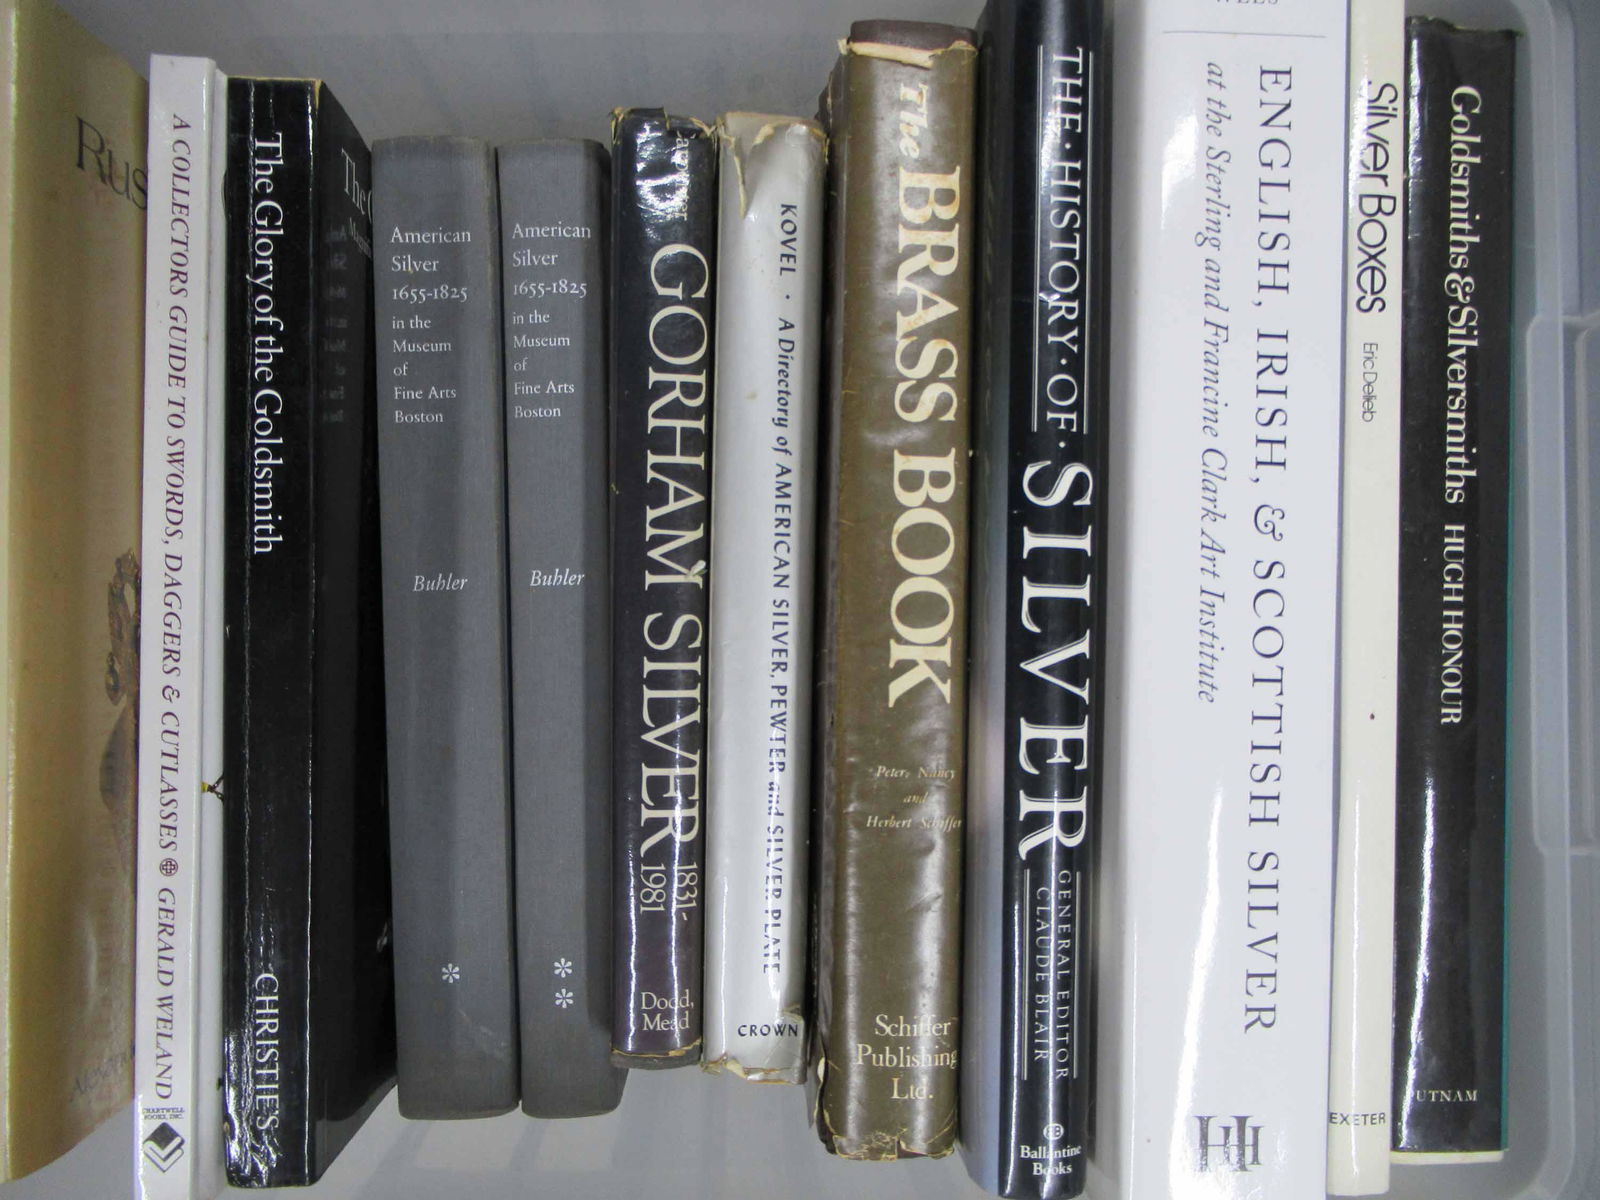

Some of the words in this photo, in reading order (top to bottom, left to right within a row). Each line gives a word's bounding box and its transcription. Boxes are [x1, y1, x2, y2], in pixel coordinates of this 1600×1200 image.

[1051, 47, 1084, 133] THE
[1205, 62, 1226, 89] at
[172, 114, 191, 131] A
[898, 83, 930, 160] The
[1204, 97, 1230, 137] the
[1358, 81, 1398, 187] Silver
[252, 132, 283, 193] The
[1251, 65, 1292, 307] ENGLISH,
[1447, 85, 1483, 268] Goldsmiths
[168, 139, 191, 297] COLLECTORS
[1194, 146, 1231, 251] Sterling
[245, 200, 283, 290] Glory
[390, 226, 472, 244] American
[512, 221, 592, 239] American
[777, 203, 797, 276] KOVEL
[1045, 160, 1081, 353] HISTORY
[1355, 194, 1397, 313] Boxes
[391, 254, 440, 272] Silver
[512, 249, 559, 268] Silver
[1202, 258, 1229, 312] and
[252, 295, 283, 331] of
[392, 284, 468, 304] 1655-1825
[513, 278, 588, 298] 1655-1825
[893, 165, 961, 422] BRASS
[1443, 272, 1475, 303] &
[392, 316, 405, 330] in
[409, 315, 432, 330] the
[513, 312, 524, 325] in
[529, 309, 551, 324] the
[513, 335, 571, 349] Museum
[777, 318, 795, 333] A
[166, 305, 188, 387] GUIDE
[252, 335, 283, 382] the
[392, 339, 452, 353] Museum
[393, 361, 409, 377] of
[514, 357, 529, 372] of
[1361, 343, 1379, 371] Eric
[394, 386, 423, 400] Fine
[428, 385, 457, 400] Arts
[514, 381, 541, 396] Fine
[545, 380, 575, 395] Arts
[770, 339, 796, 428] Directory
[1044, 373, 1078, 432] OF
[1200, 317, 1229, 437] Francine
[1360, 371, 1379, 423] Delieb
[1443, 305, 1480, 504] Silversmiths
[165, 395, 186, 429] TO
[395, 410, 444, 424] Boston
[514, 405, 562, 418] Boston
[642, 243, 709, 590] GORHAM
[1248, 328, 1289, 484] IRISH,
[252, 389, 283, 554] Goldsmith
[772, 436, 792, 457] of
[161, 436, 185, 545] SWORDS,
[1199, 448, 1228, 521] Clark
[771, 463, 792, 589] AMERICAN
[1252, 503, 1286, 541] &
[413, 572, 468, 592] Buhler
[530, 567, 585, 587] Buhler
[887, 448, 956, 708] BOOK
[1198, 528, 1227, 580] Art
[1441, 524, 1465, 603] HUGH
[159, 553, 183, 676] DAGGERS
[768, 599, 790, 678] SILVER,
[1017, 461, 1092, 860] SILVER
[1196, 588, 1226, 704] Institute
[1439, 609, 1463, 725] HONOUR
[161, 685, 182, 703] &
[1247, 559, 1285, 827] SCOTTISH
[639, 611, 703, 858] SILVER
[767, 685, 789, 774] PEWTER
[158, 711, 181, 850] CUTLASSES
[766, 781, 784, 817] and
[866, 815, 912, 829] Herbert
[638, 863, 667, 914] 1981
[763, 825, 785, 900] SILVER
[673, 862, 698, 920] 1831-
[155, 888, 176, 987] GERALD
[761, 909, 782, 974] PLATE
[1034, 887, 1050, 982] CLAUDE
[1056, 870, 1072, 980] GENERAL
[1242, 851, 1280, 1033] SILVER
[641, 988, 694, 1011] Dodd,
[642, 1012, 690, 1031] Mead
[874, 1014, 952, 1037] Schiffer
[1032, 994, 1049, 1061] BLAIR
[153, 995, 174, 1099] WELAND
[255, 973, 280, 1130] CHRISTIE'S
[738, 1025, 798, 1038] CROWN
[856, 1043, 958, 1069] Publishing
[1053, 991, 1070, 1080] EDITOR
[890, 1077, 934, 1100] Ltd.
[1408, 1089, 1478, 1102] UTNAM
[1328, 1112, 1386, 1126] EXETER
[1020, 1145, 1081, 1159] Ballantine
[1033, 1161, 1072, 1176] Books
